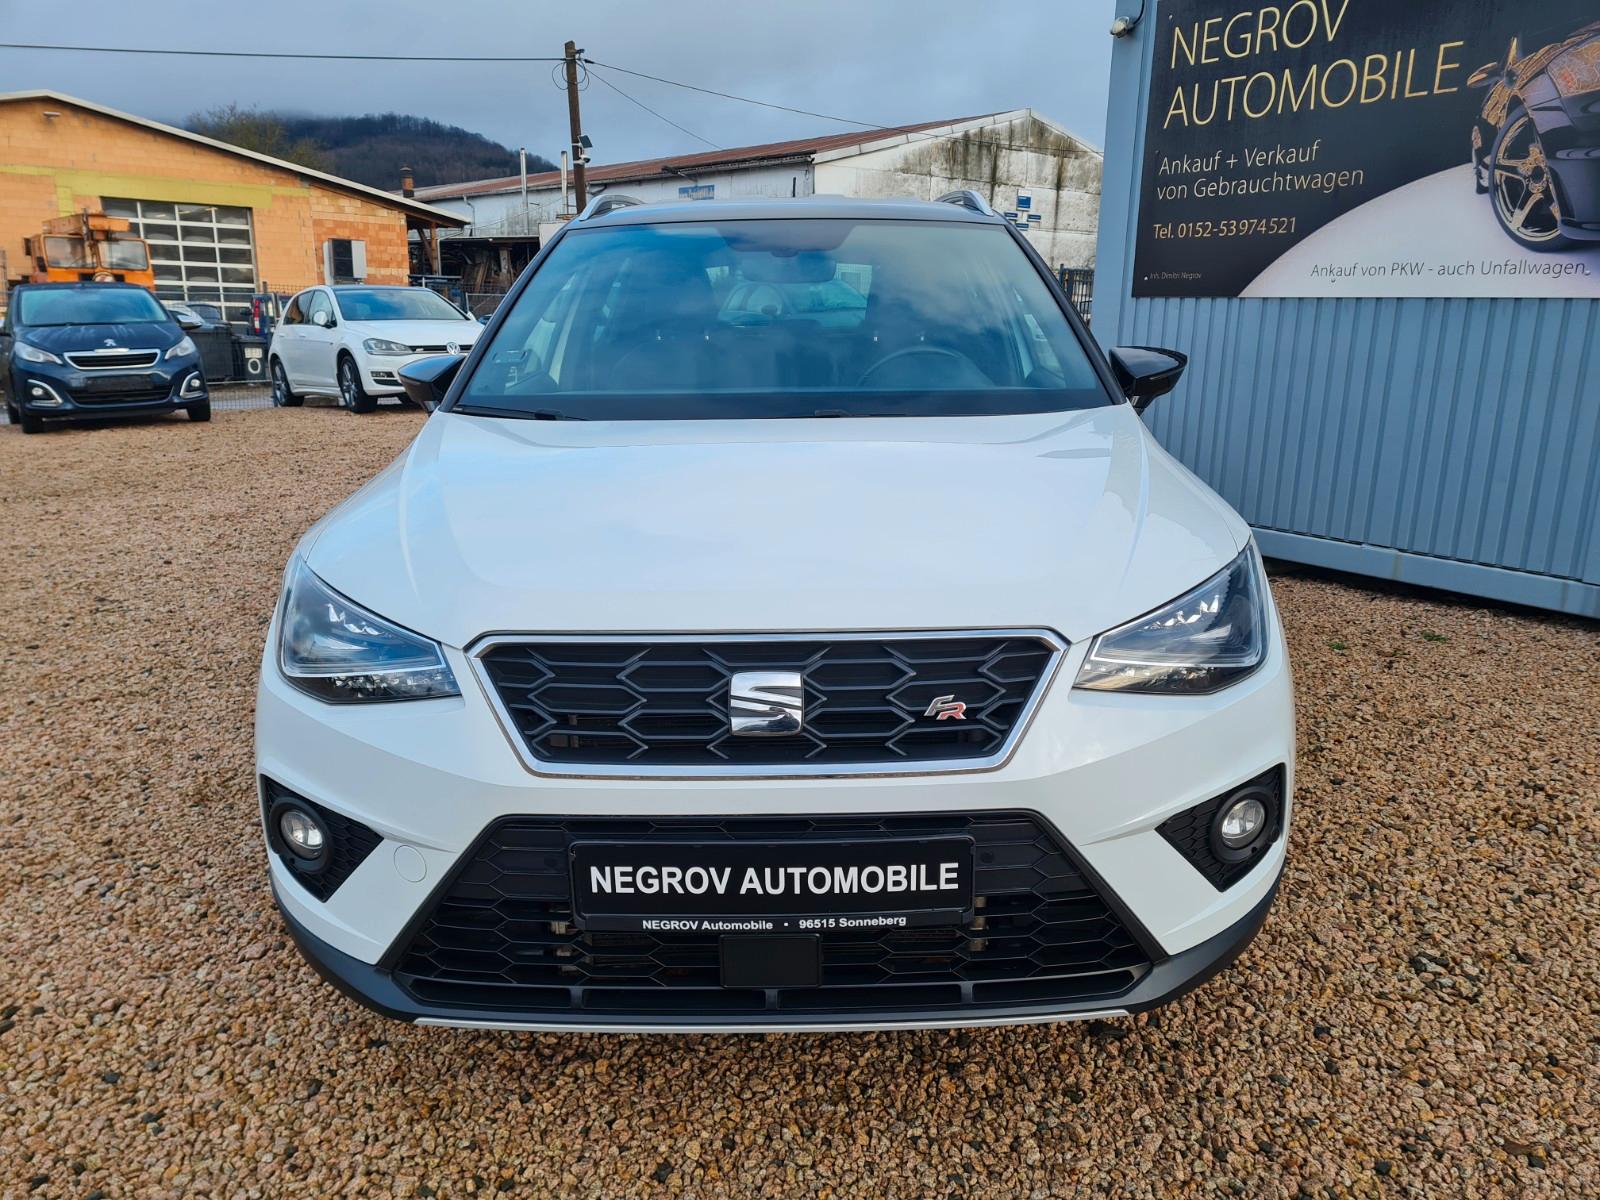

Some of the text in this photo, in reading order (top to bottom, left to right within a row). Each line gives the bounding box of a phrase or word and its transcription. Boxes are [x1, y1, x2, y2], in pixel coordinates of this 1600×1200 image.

[1170, 0, 1349, 69] NEGROV
[1163, 40, 1464, 129] AUTOMOBILE
[1158, 150, 1222, 176] Ankauf
[1244, 139, 1321, 168] Verkauf
[1157, 169, 1364, 200] von Gebrauchtwagen
[1153, 223, 1174, 239] Tel.
[1310, 263, 1357, 277] Ankauf
[1360, 265, 1386, 277] von
[1390, 262, 1425, 276] PKW
[1437, 260, 1475, 276] auch
[1480, 259, 1586, 279] Unfallwagen
[590, 862, 959, 895] NEGROV AUTOMOBILE
[642, 915, 907, 931] NEGROV Automobile 96515 Sonneberg
